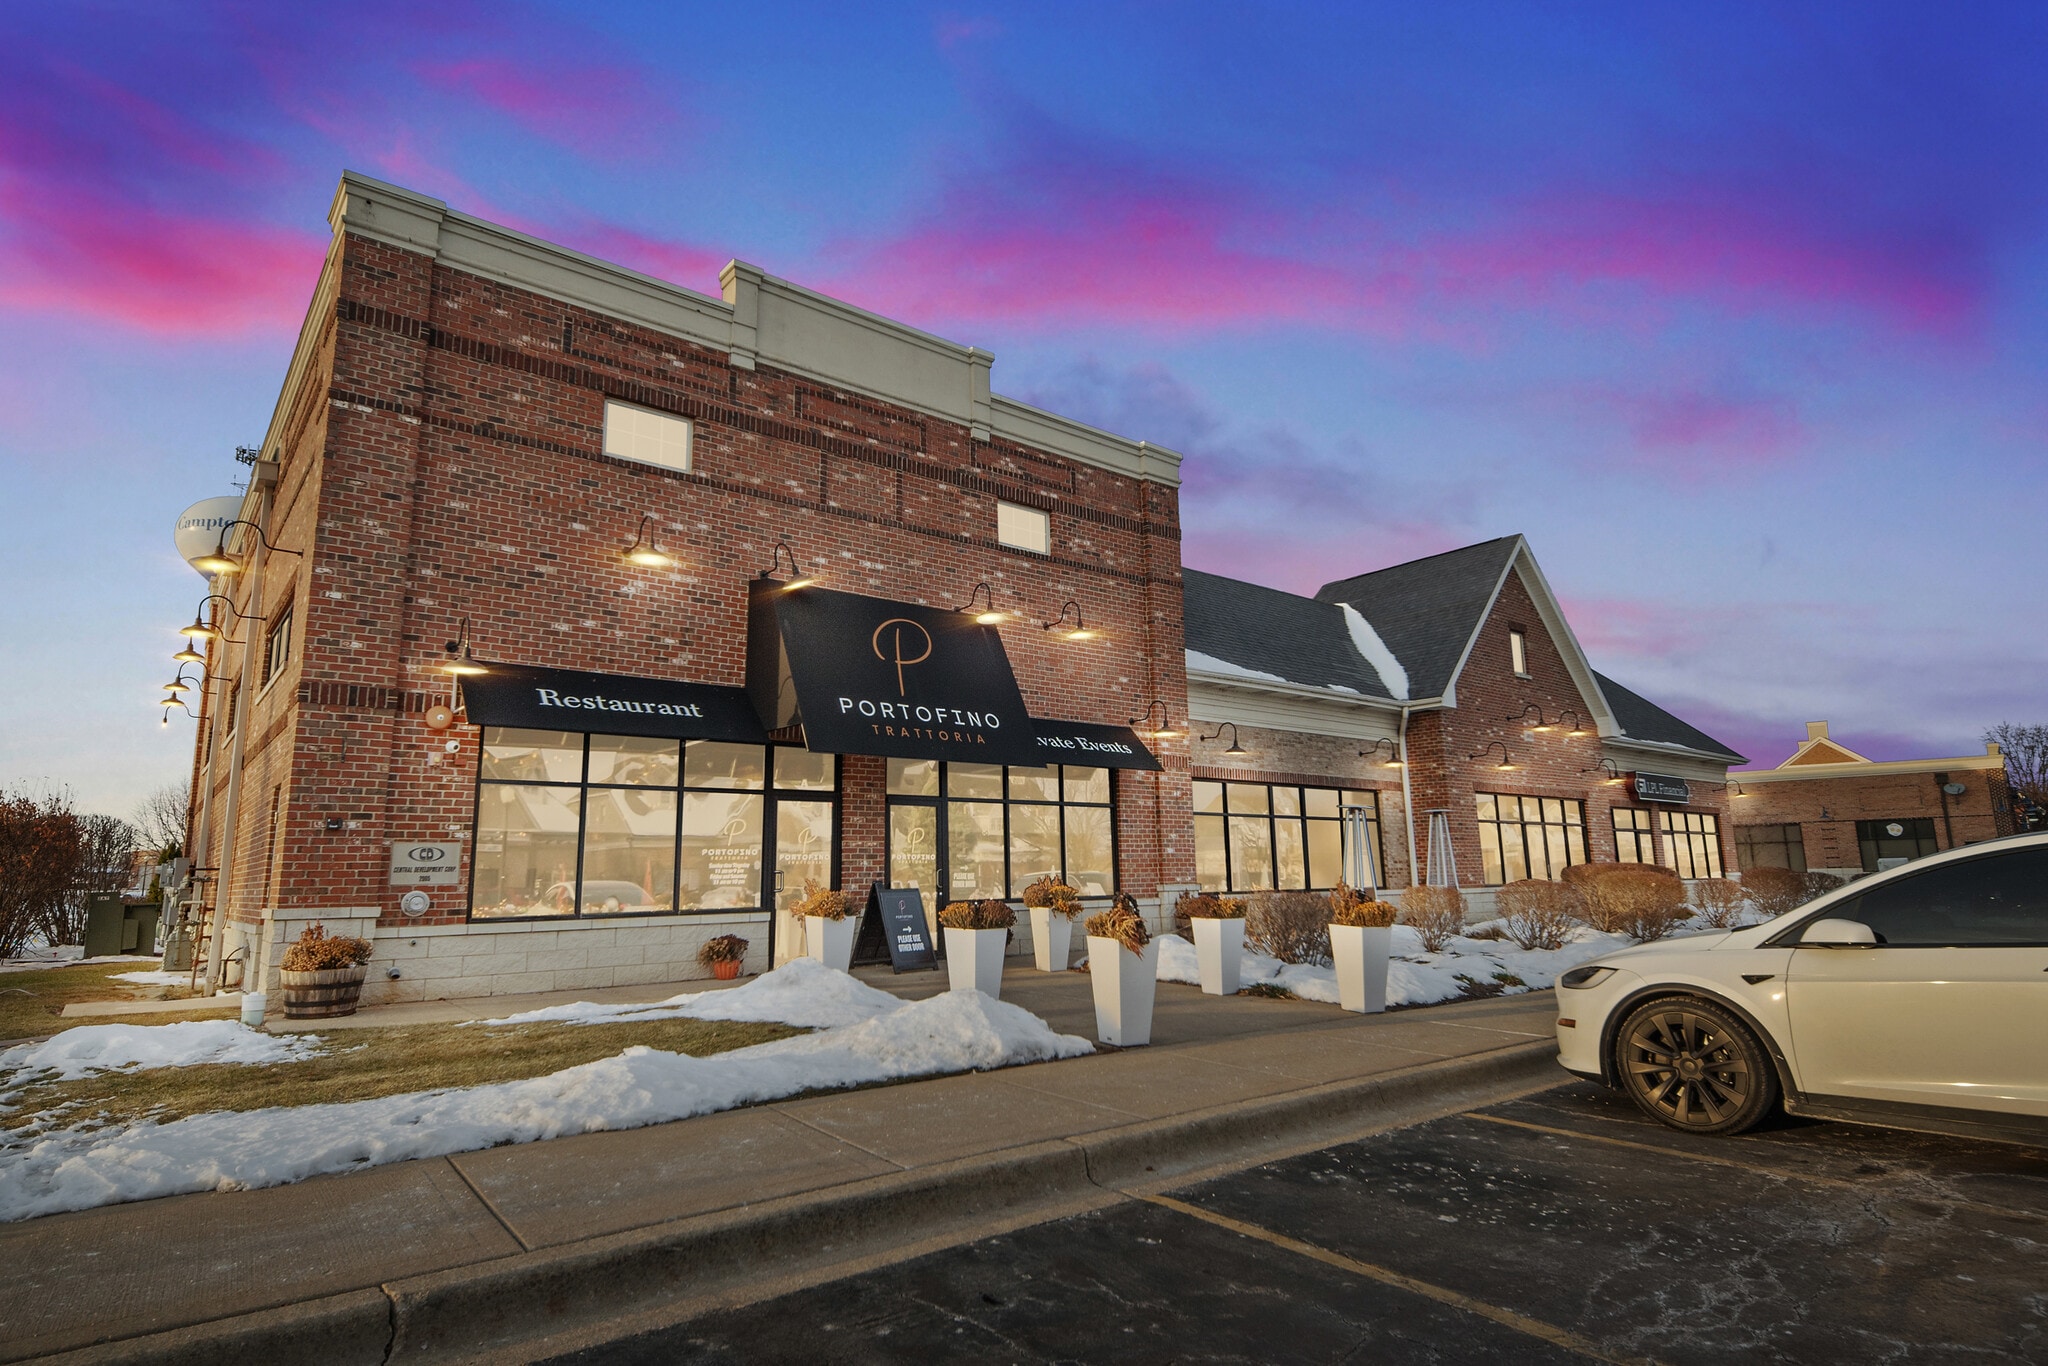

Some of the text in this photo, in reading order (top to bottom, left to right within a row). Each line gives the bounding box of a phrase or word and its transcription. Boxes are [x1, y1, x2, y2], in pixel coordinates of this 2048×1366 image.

[535, 688, 704, 718] Restaurant
[838, 697, 1000, 729] PORTOFINO
[871, 724, 986, 744] TRATTORIA
[1036, 736, 1133, 754] vate Events
[701, 848, 758, 856] PORTOFINO
[779, 853, 830, 861] PORTOFINO
[891, 853, 936, 861] PORTOFINO
[897, 933, 922, 944] PLEASE USE
[898, 942, 925, 953] OTHER DOOR
